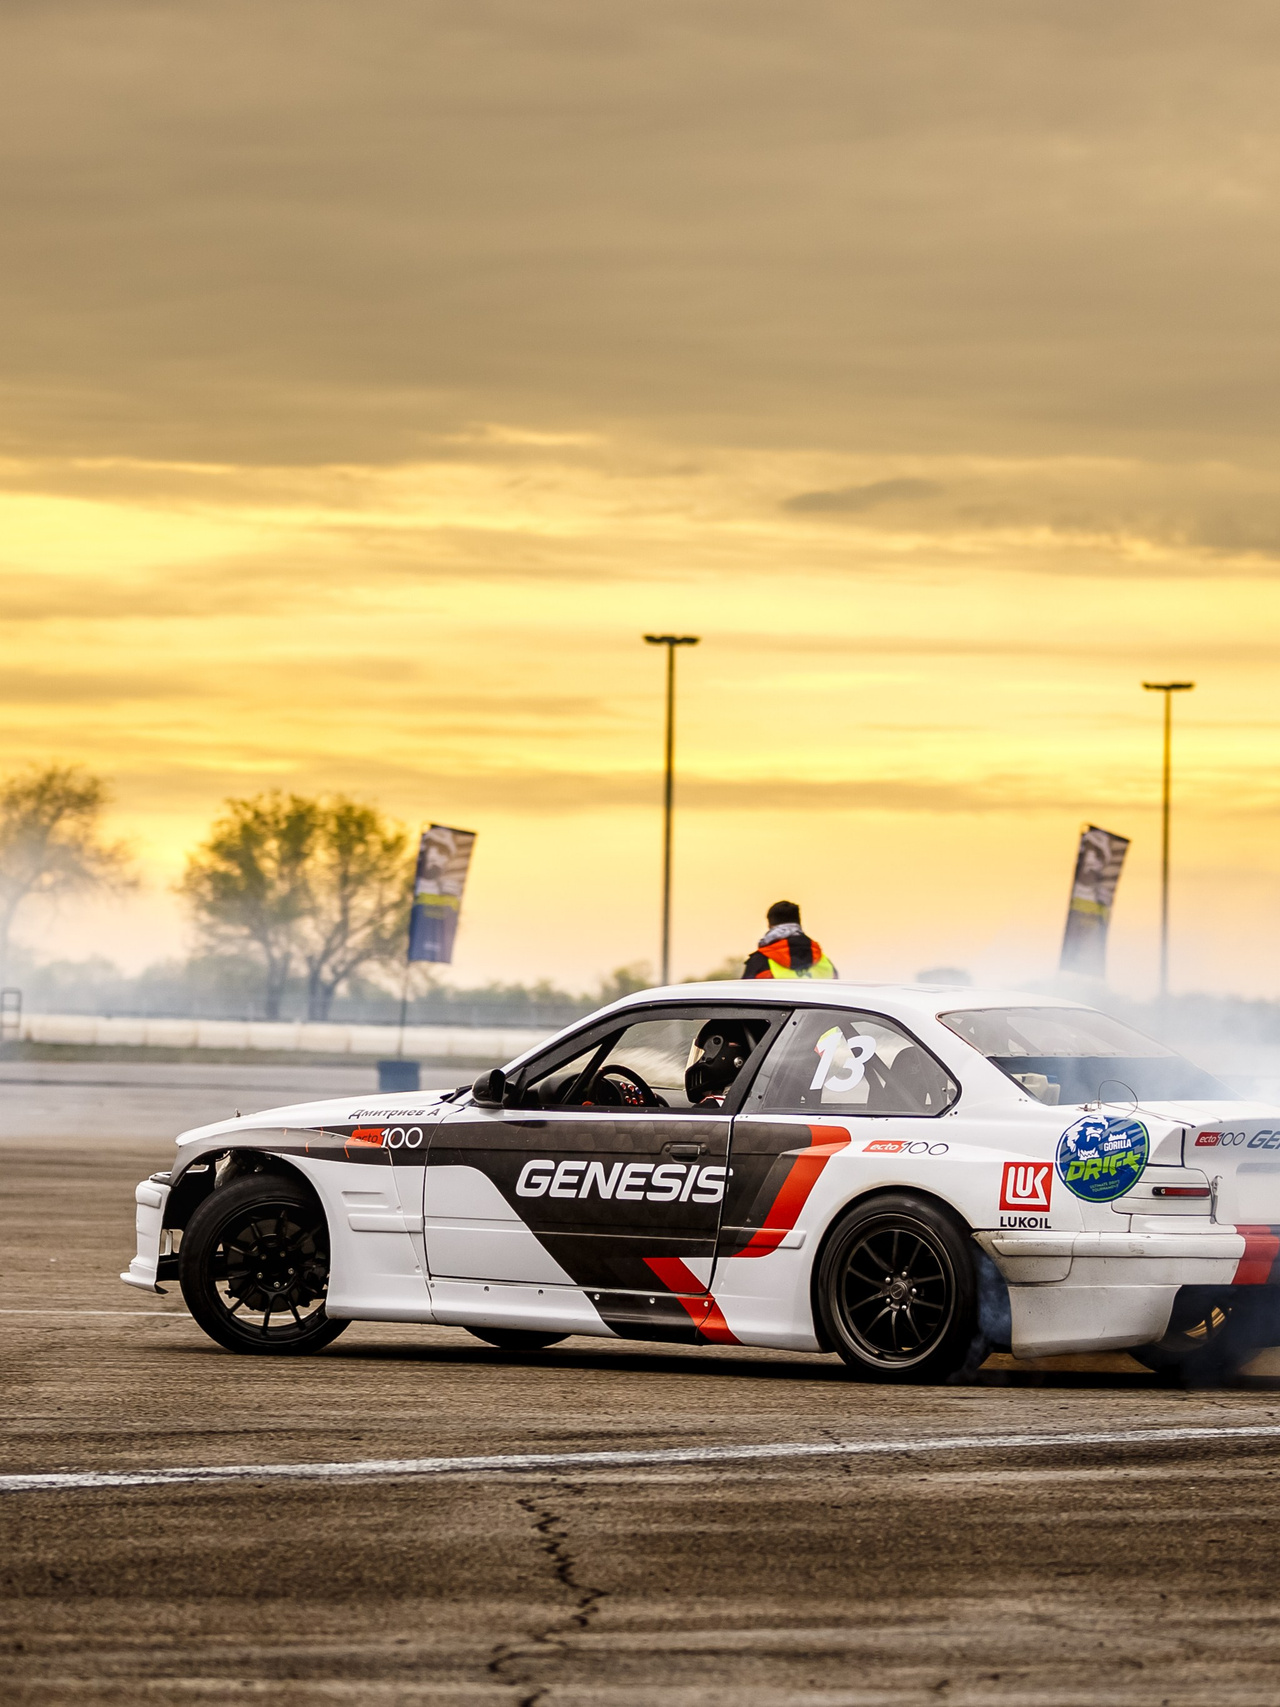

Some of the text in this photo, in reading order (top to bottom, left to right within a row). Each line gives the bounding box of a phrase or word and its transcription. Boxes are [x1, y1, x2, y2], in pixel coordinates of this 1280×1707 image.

[810, 1029, 877, 1092] 13
[348, 1108, 425, 1120] Дмитриев
[1103, 1138, 1132, 1152] GORILLA
[1066, 1150, 1142, 1182] DRIFT
[515, 1159, 734, 1204] GENESIS
[1000, 1215, 1052, 1229] LUKOIL
